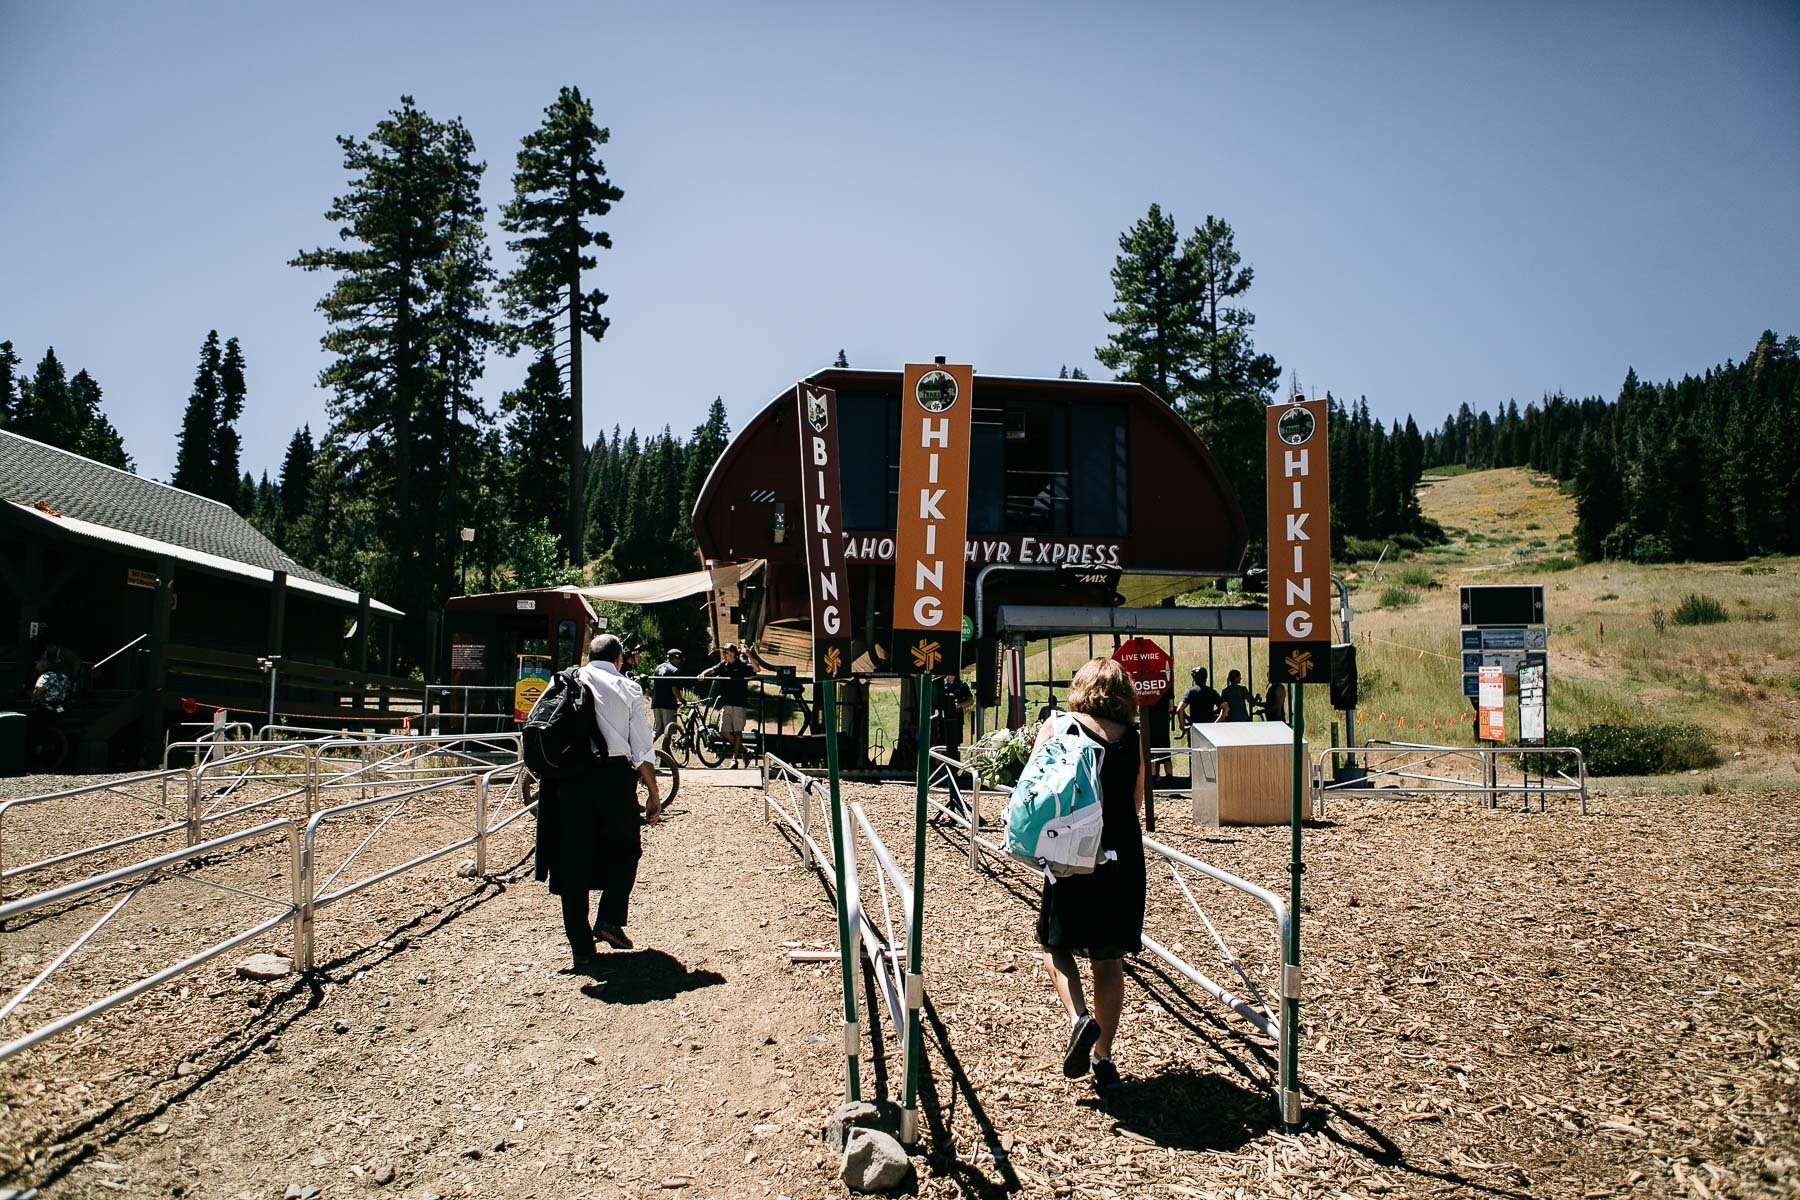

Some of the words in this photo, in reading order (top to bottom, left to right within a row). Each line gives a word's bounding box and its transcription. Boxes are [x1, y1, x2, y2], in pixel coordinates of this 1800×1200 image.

[813, 436, 841, 636] BIKING
[913, 418, 949, 627] HIKING
[842, 532, 896, 559] AHO
[966, 541, 1011, 563] HYR
[1019, 537, 1120, 564] EXPRESS
[1284, 449, 1313, 638] HIKING
[1080, 574, 1108, 583] MIX
[1121, 653, 1139, 662] LIVE
[1140, 652, 1160, 660] WIRE
[1134, 679, 1167, 691] OSED
